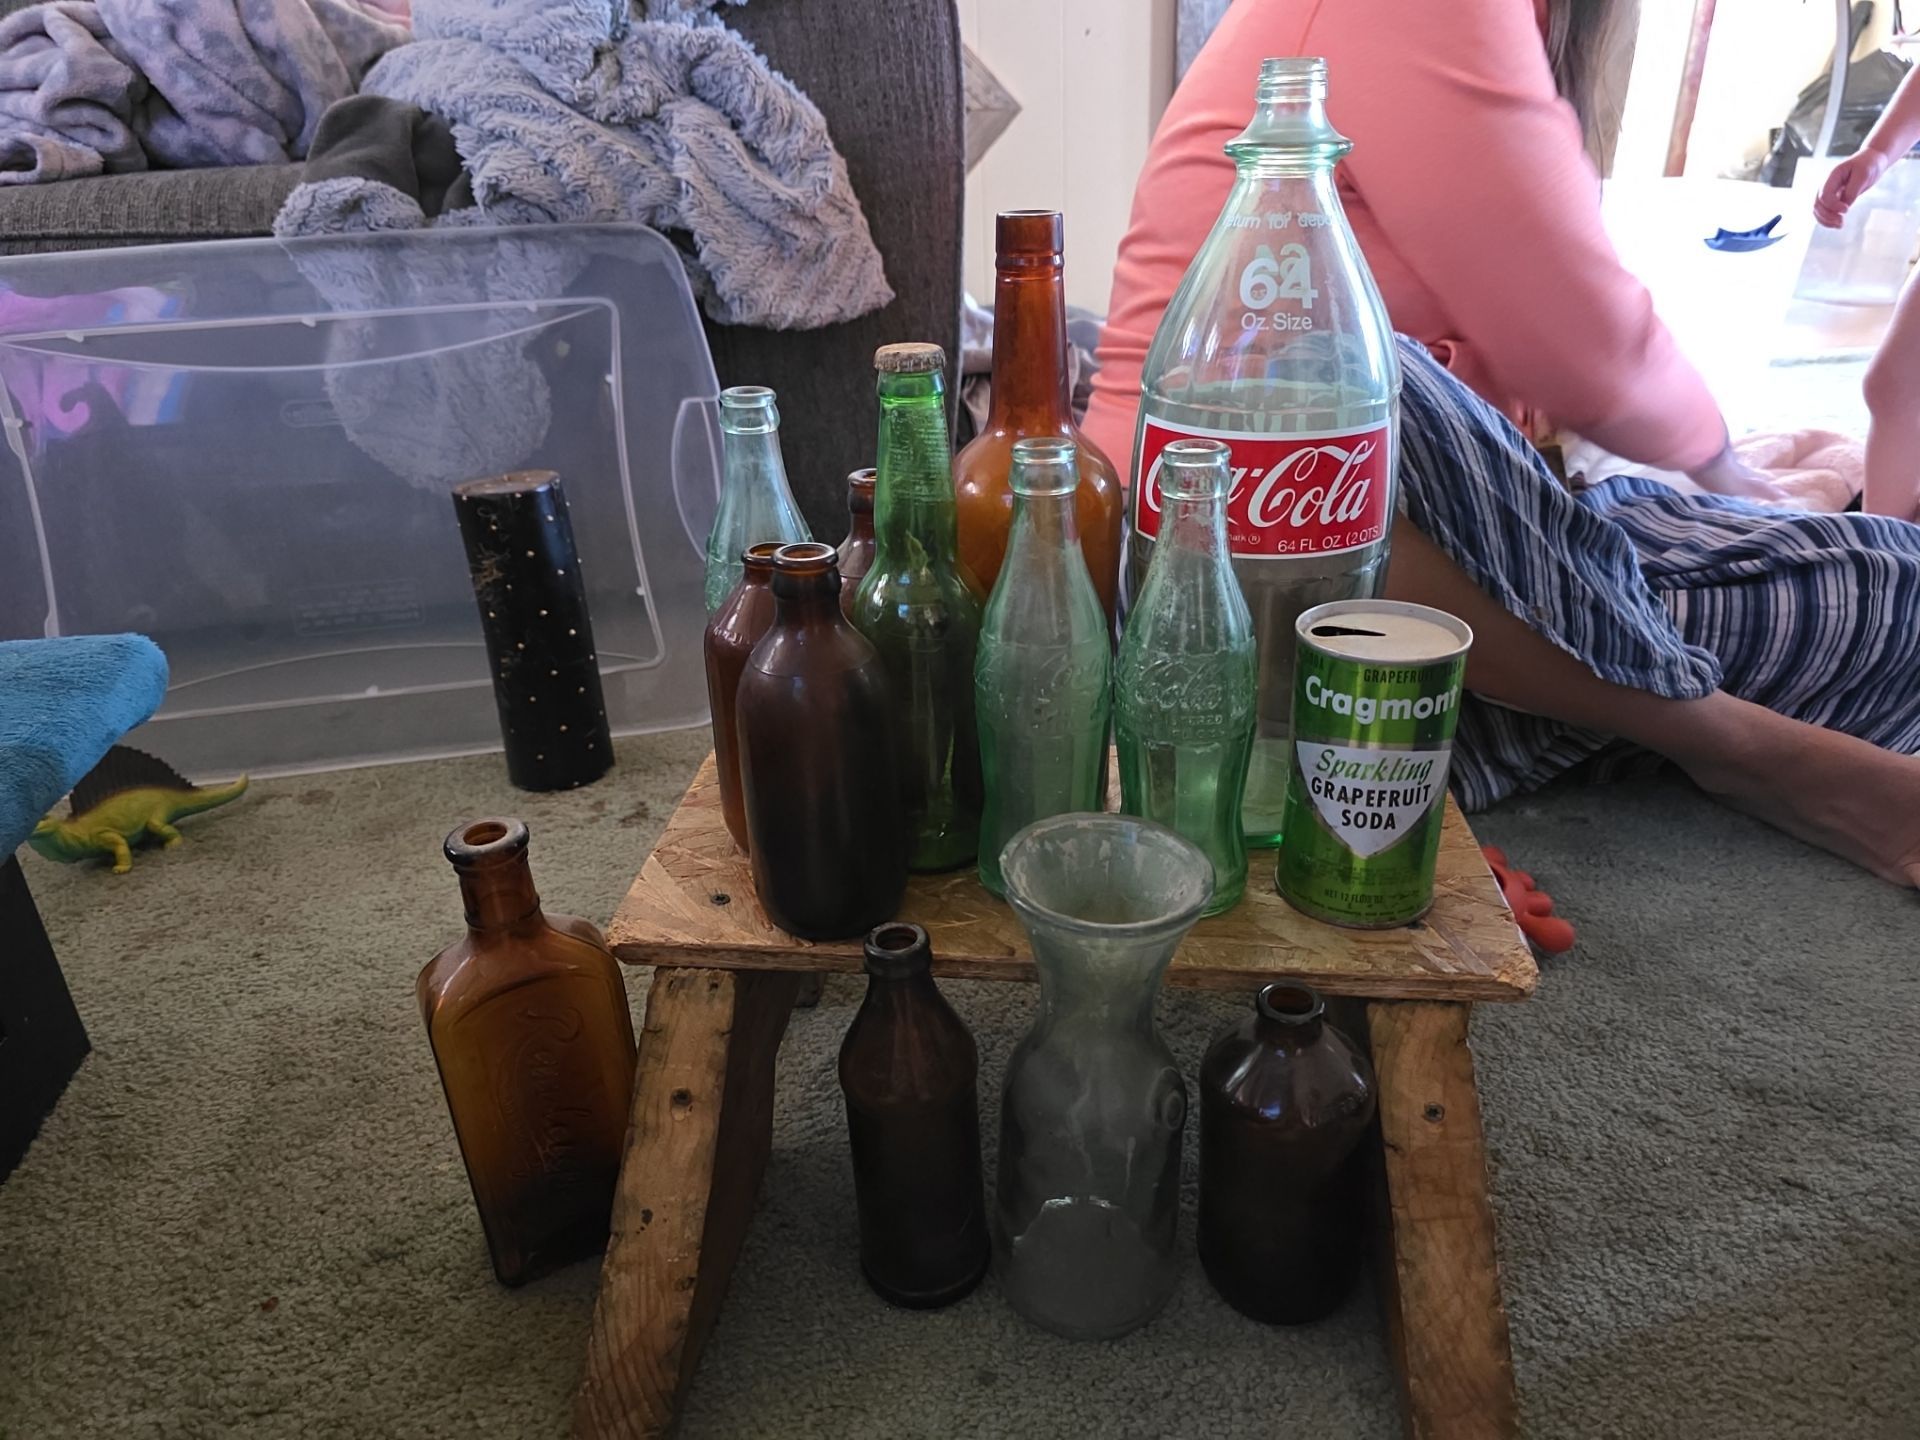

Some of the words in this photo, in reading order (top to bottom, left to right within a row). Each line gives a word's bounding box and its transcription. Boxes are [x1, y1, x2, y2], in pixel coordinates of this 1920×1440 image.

[1240, 257, 1318, 310] 64
[1273, 312, 1312, 331] Size
[1145, 439, 1377, 528] a-Cola
[1278, 540, 1296, 553] 64
[1300, 538, 1317, 552] FL
[1322, 535, 1342, 549] OZ
[1305, 675, 1459, 725] Cragmont
[1316, 748, 1434, 785] Sparkling
[1311, 776, 1431, 808] GRAPEFRUIT
[1341, 809, 1396, 830] SODA
